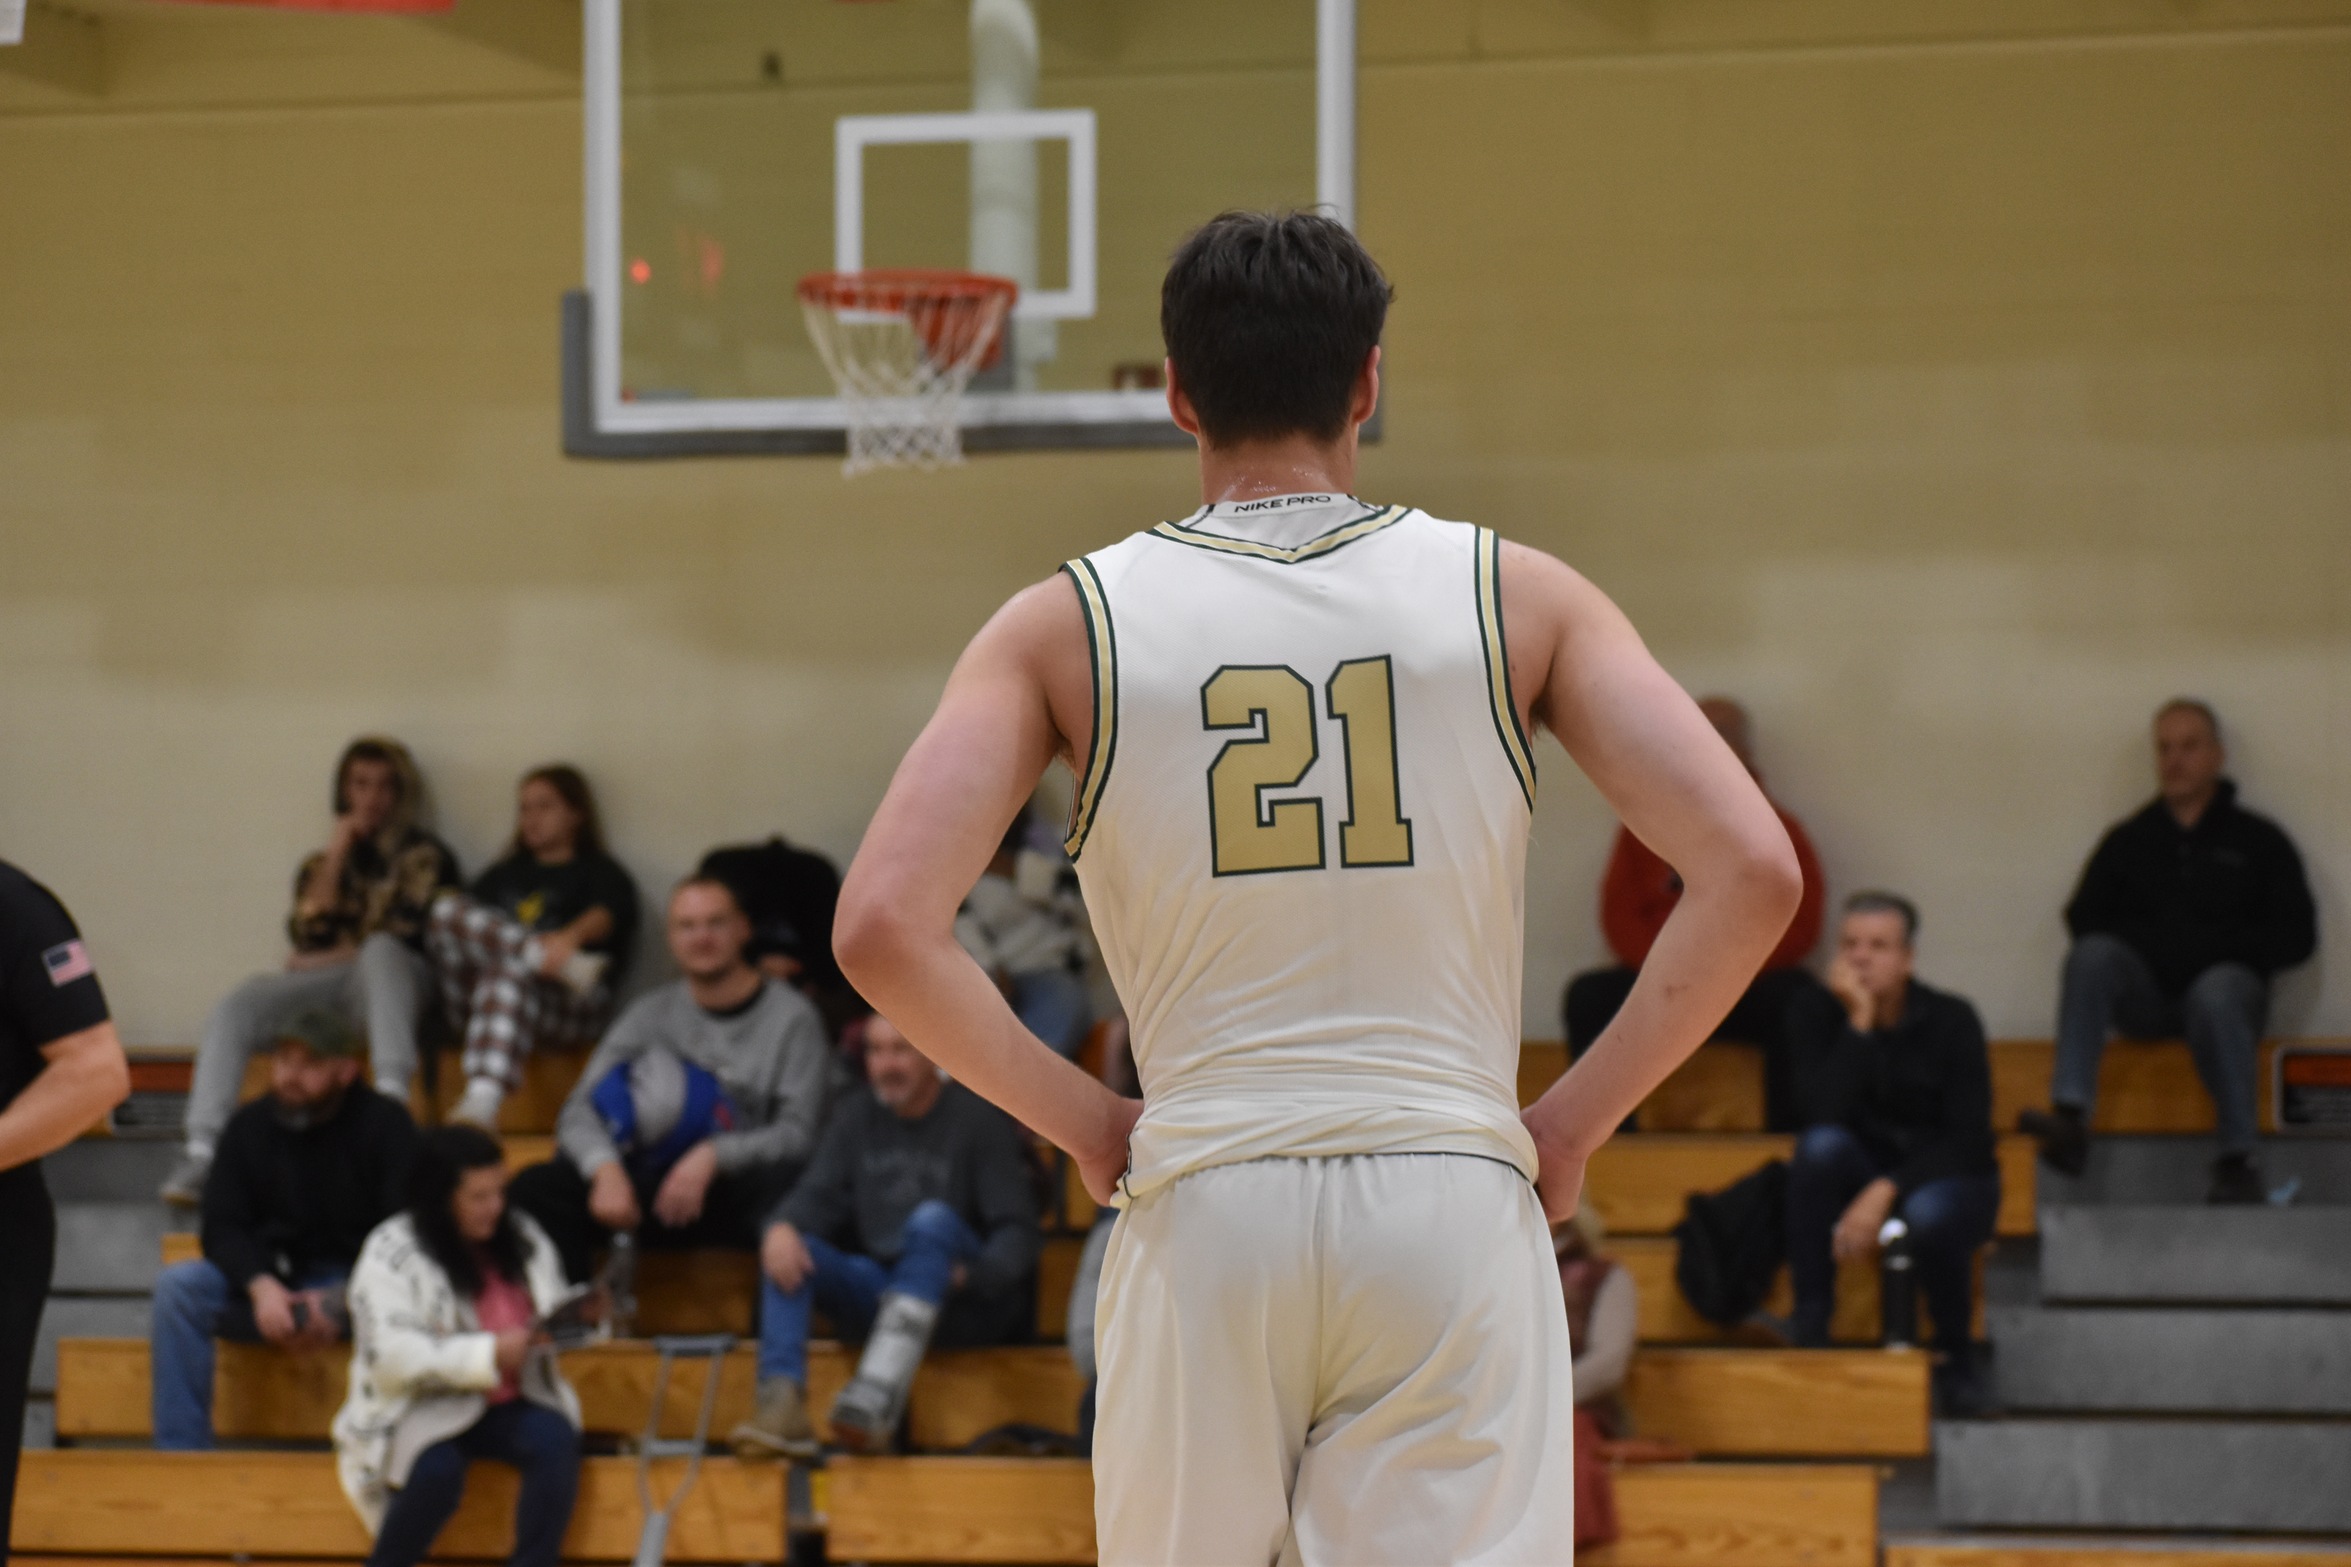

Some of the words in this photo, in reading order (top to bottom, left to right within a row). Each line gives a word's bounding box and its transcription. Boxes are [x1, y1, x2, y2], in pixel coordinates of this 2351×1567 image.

[1234, 499, 1284, 512] NIKE
[1287, 495, 1331, 506] PRO
[1200, 654, 1414, 878] 21
